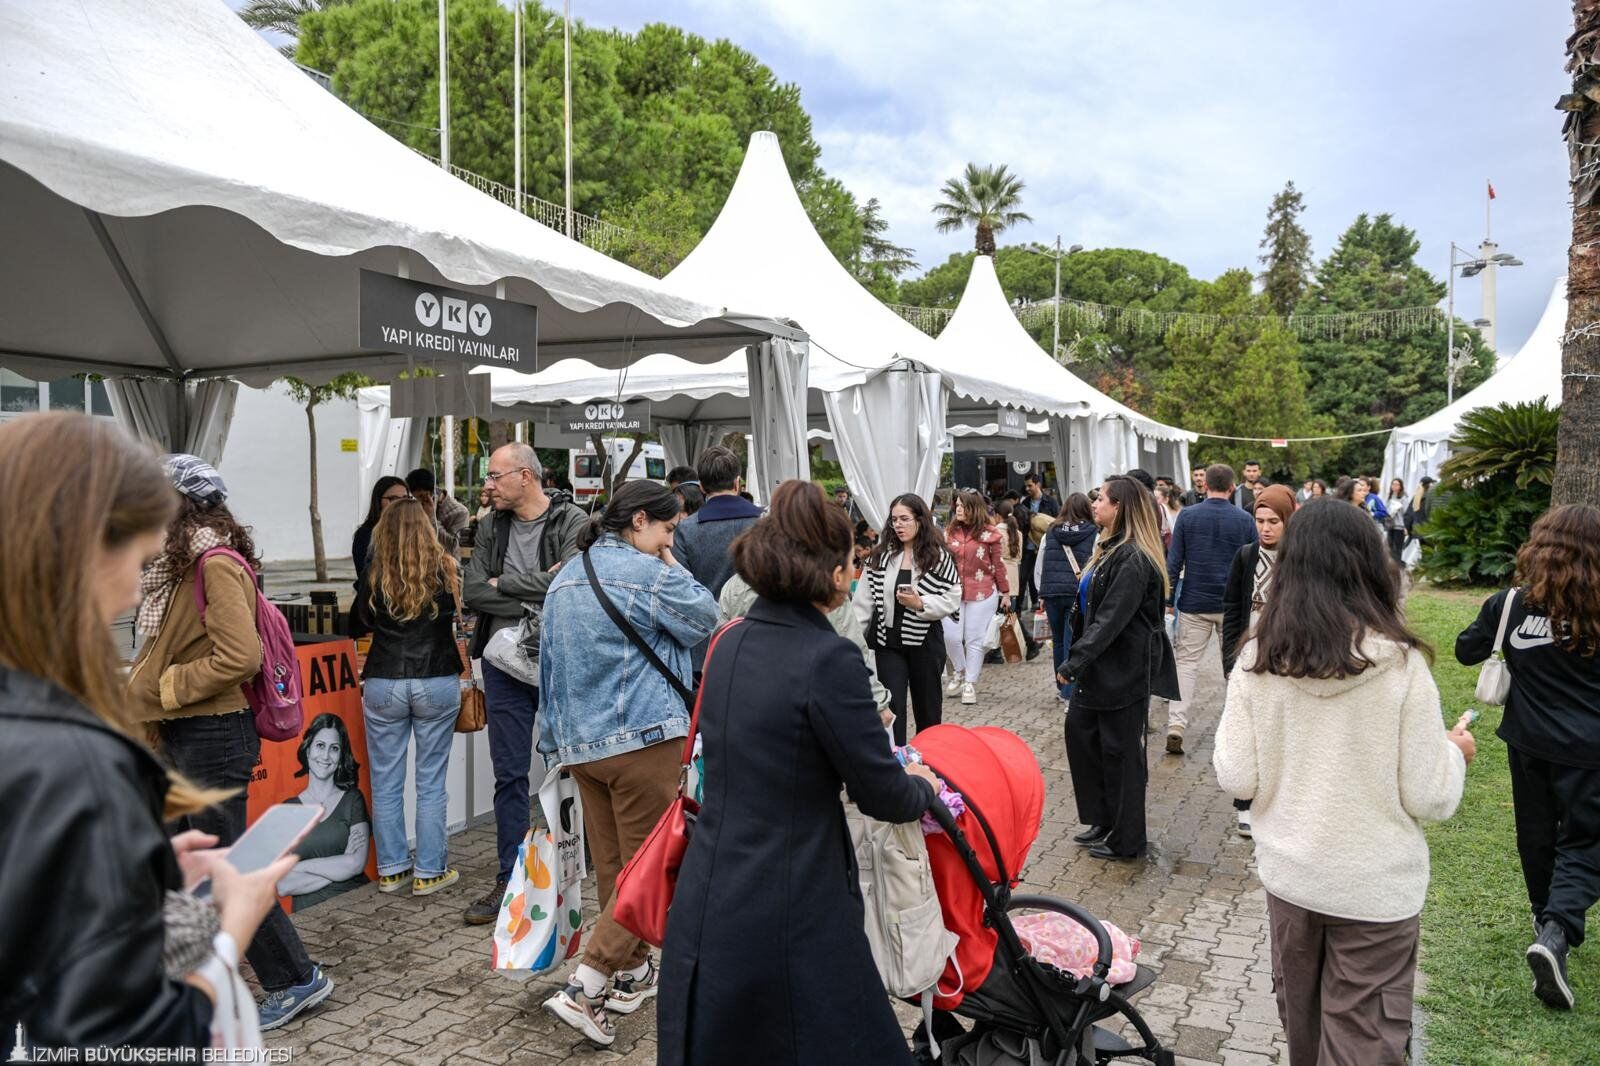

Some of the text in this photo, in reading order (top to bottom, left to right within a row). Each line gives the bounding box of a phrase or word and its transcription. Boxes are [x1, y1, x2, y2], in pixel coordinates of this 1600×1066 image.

[419, 297, 489, 331] YKY
[381, 325, 520, 363] YAPI KREDİ YAYINLARI
[587, 406, 623, 418] YKY
[569, 422, 585, 430] YAPI
[585, 420, 605, 430] KREDİ
[1518, 615, 1568, 637] NIK
